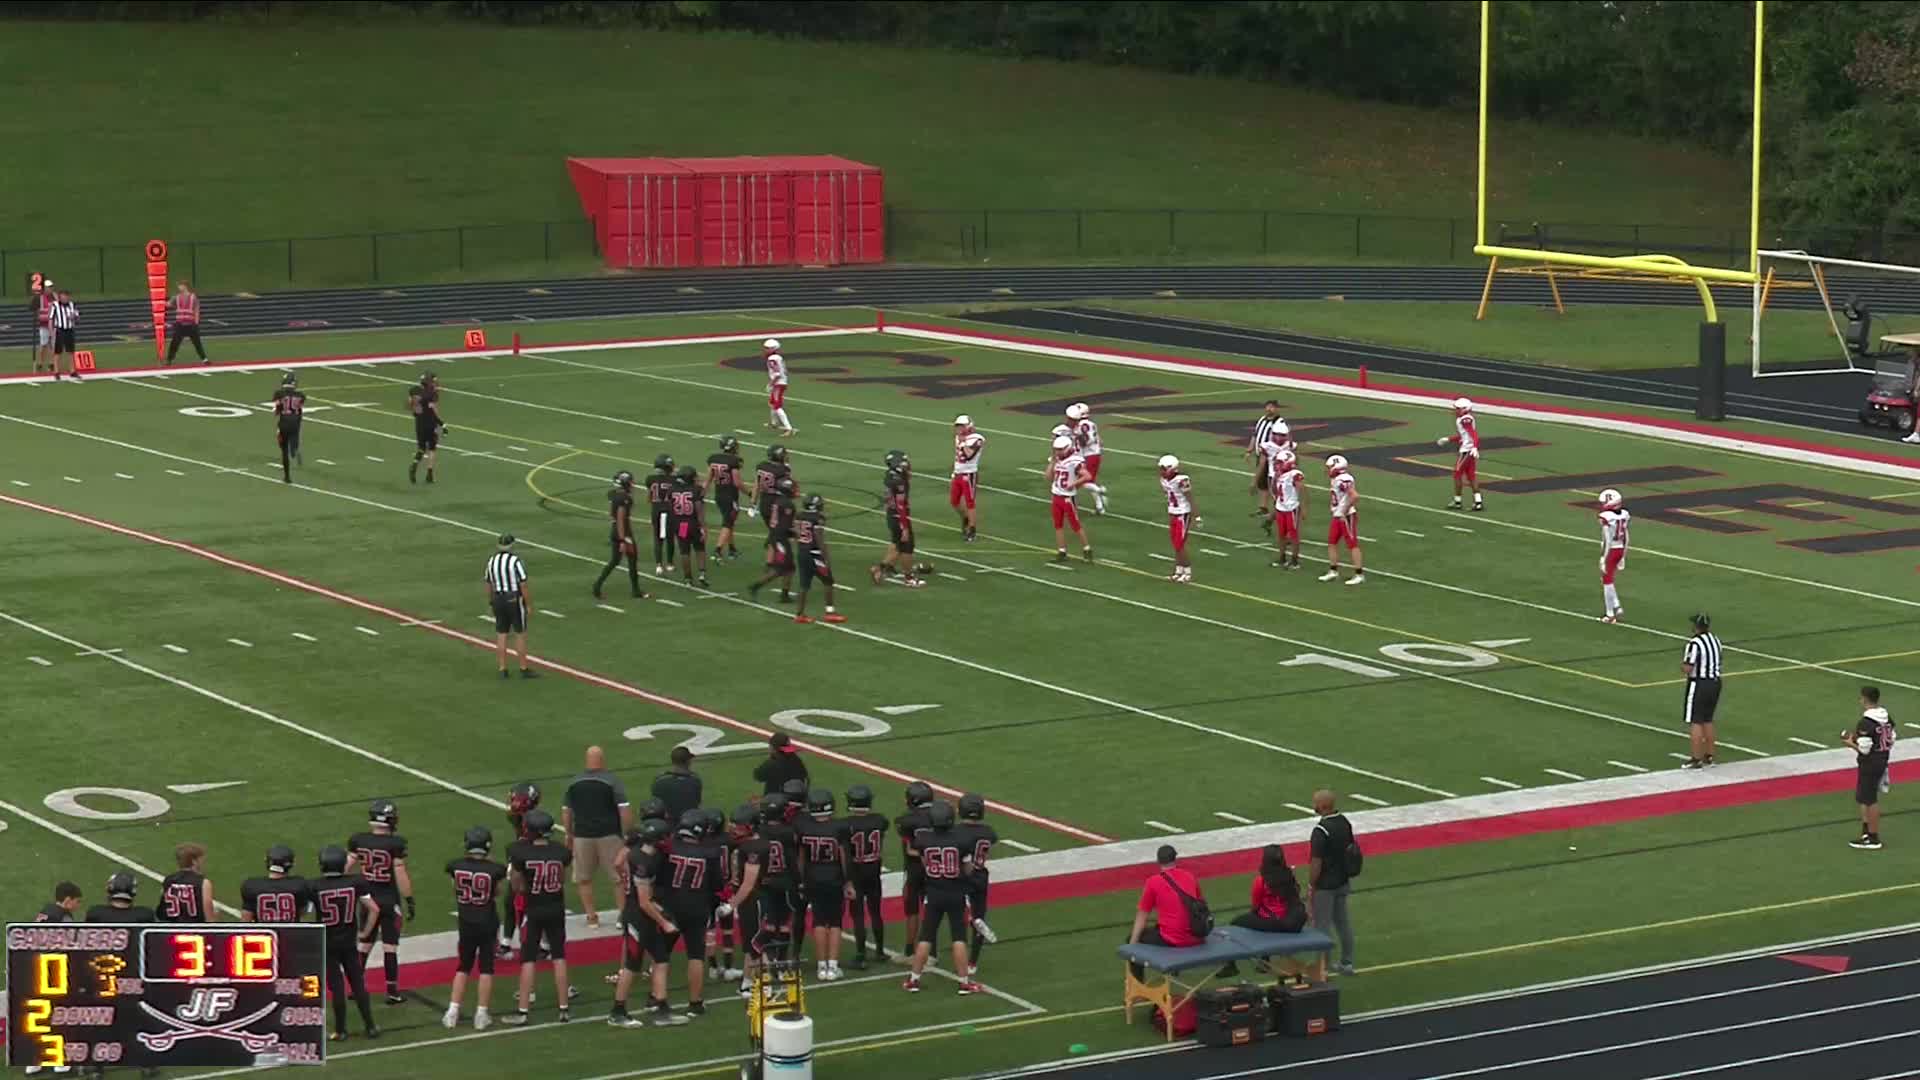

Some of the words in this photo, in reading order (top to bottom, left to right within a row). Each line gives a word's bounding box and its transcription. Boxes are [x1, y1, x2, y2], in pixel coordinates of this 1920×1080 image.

[31, 272, 43, 290] 2
[470, 331, 482, 345] G
[77, 353, 91, 368] 10
[718, 349, 1920, 556] CAVALIE
[1277, 643, 1499, 677] 10
[622, 709, 892, 756] 20
[850, 829, 881, 863] 11
[356, 847, 391, 883] 22
[525, 860, 562, 894] 70
[669, 853, 706, 889] 77
[164, 883, 197, 917] 54
[454, 869, 492, 905] 59
[319, 887, 355, 926] 57
